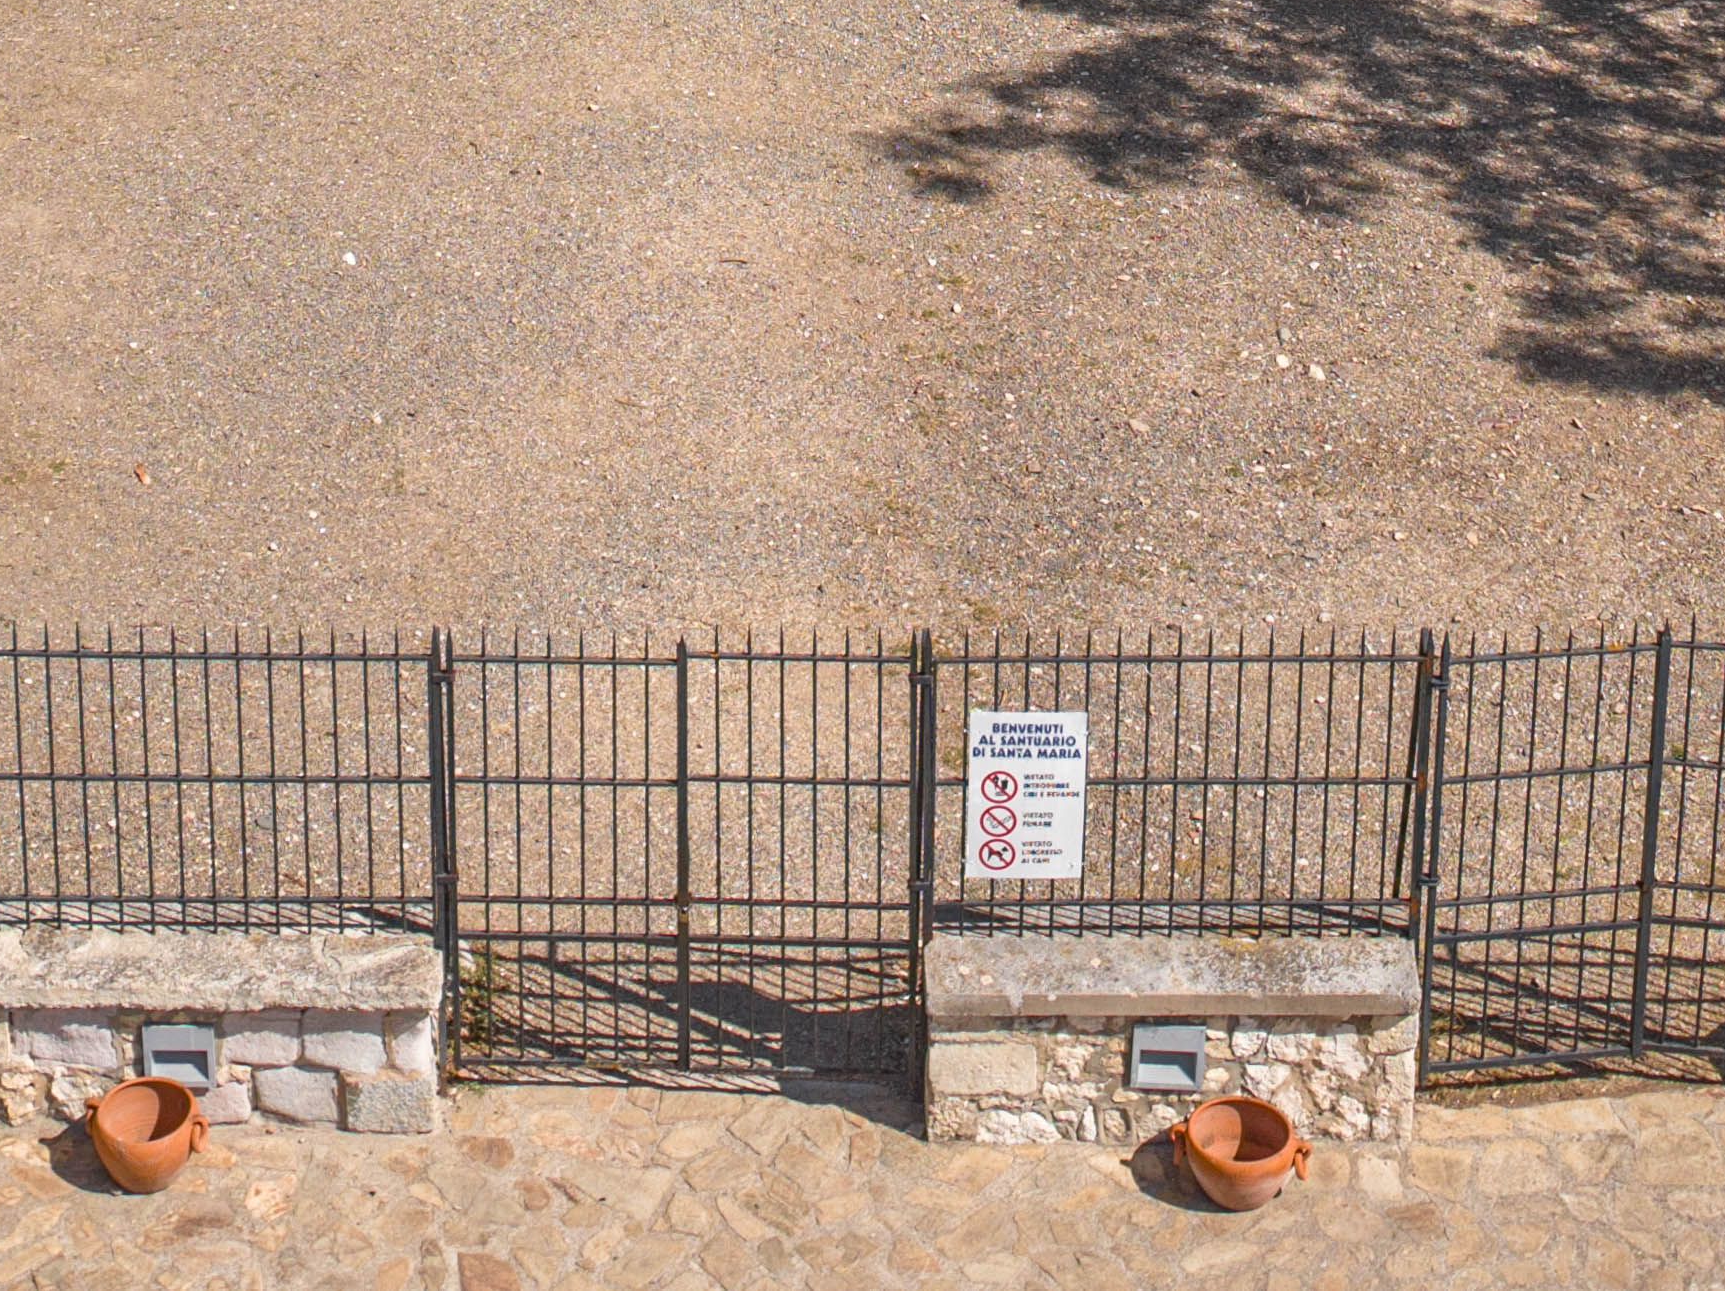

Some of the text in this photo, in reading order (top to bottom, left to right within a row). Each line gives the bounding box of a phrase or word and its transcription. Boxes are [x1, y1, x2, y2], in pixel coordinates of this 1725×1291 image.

[992, 723, 1063, 734] BENVENUTI
[979, 735, 1076, 747] AL SANTUARIO
[972, 747, 1081, 759] DI SANTA MARIA
